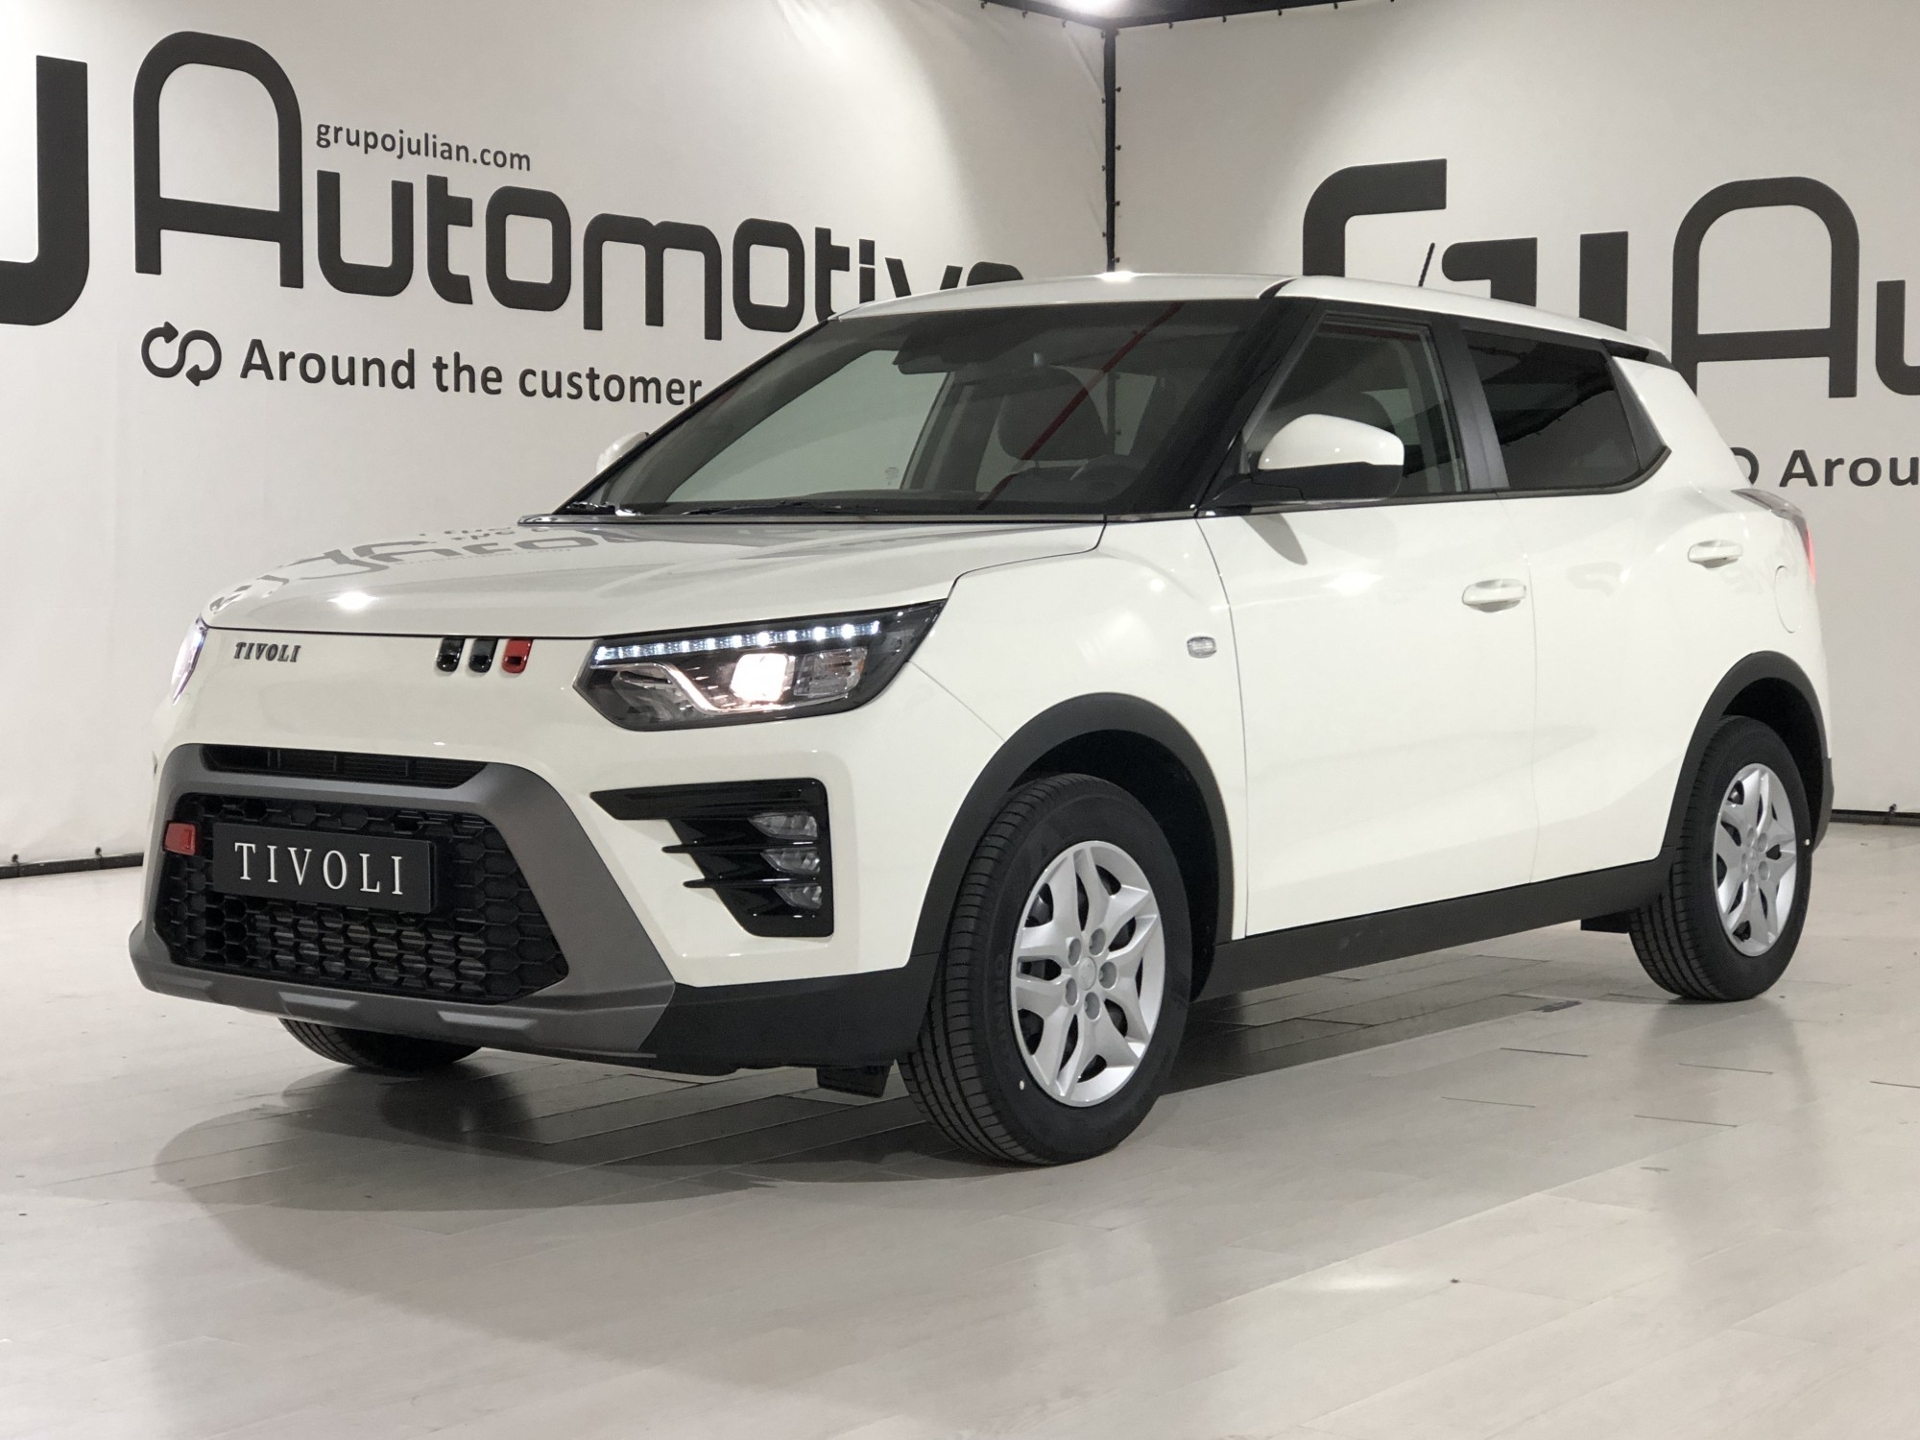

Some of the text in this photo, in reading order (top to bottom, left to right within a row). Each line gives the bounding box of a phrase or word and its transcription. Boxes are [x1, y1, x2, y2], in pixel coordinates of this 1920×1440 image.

[316, 123, 531, 171] grupojulian.com
[240, 338, 702, 406] Around the customer
[233, 641, 302, 663] TIVOLI
[234, 842, 403, 895] TIVOLI
